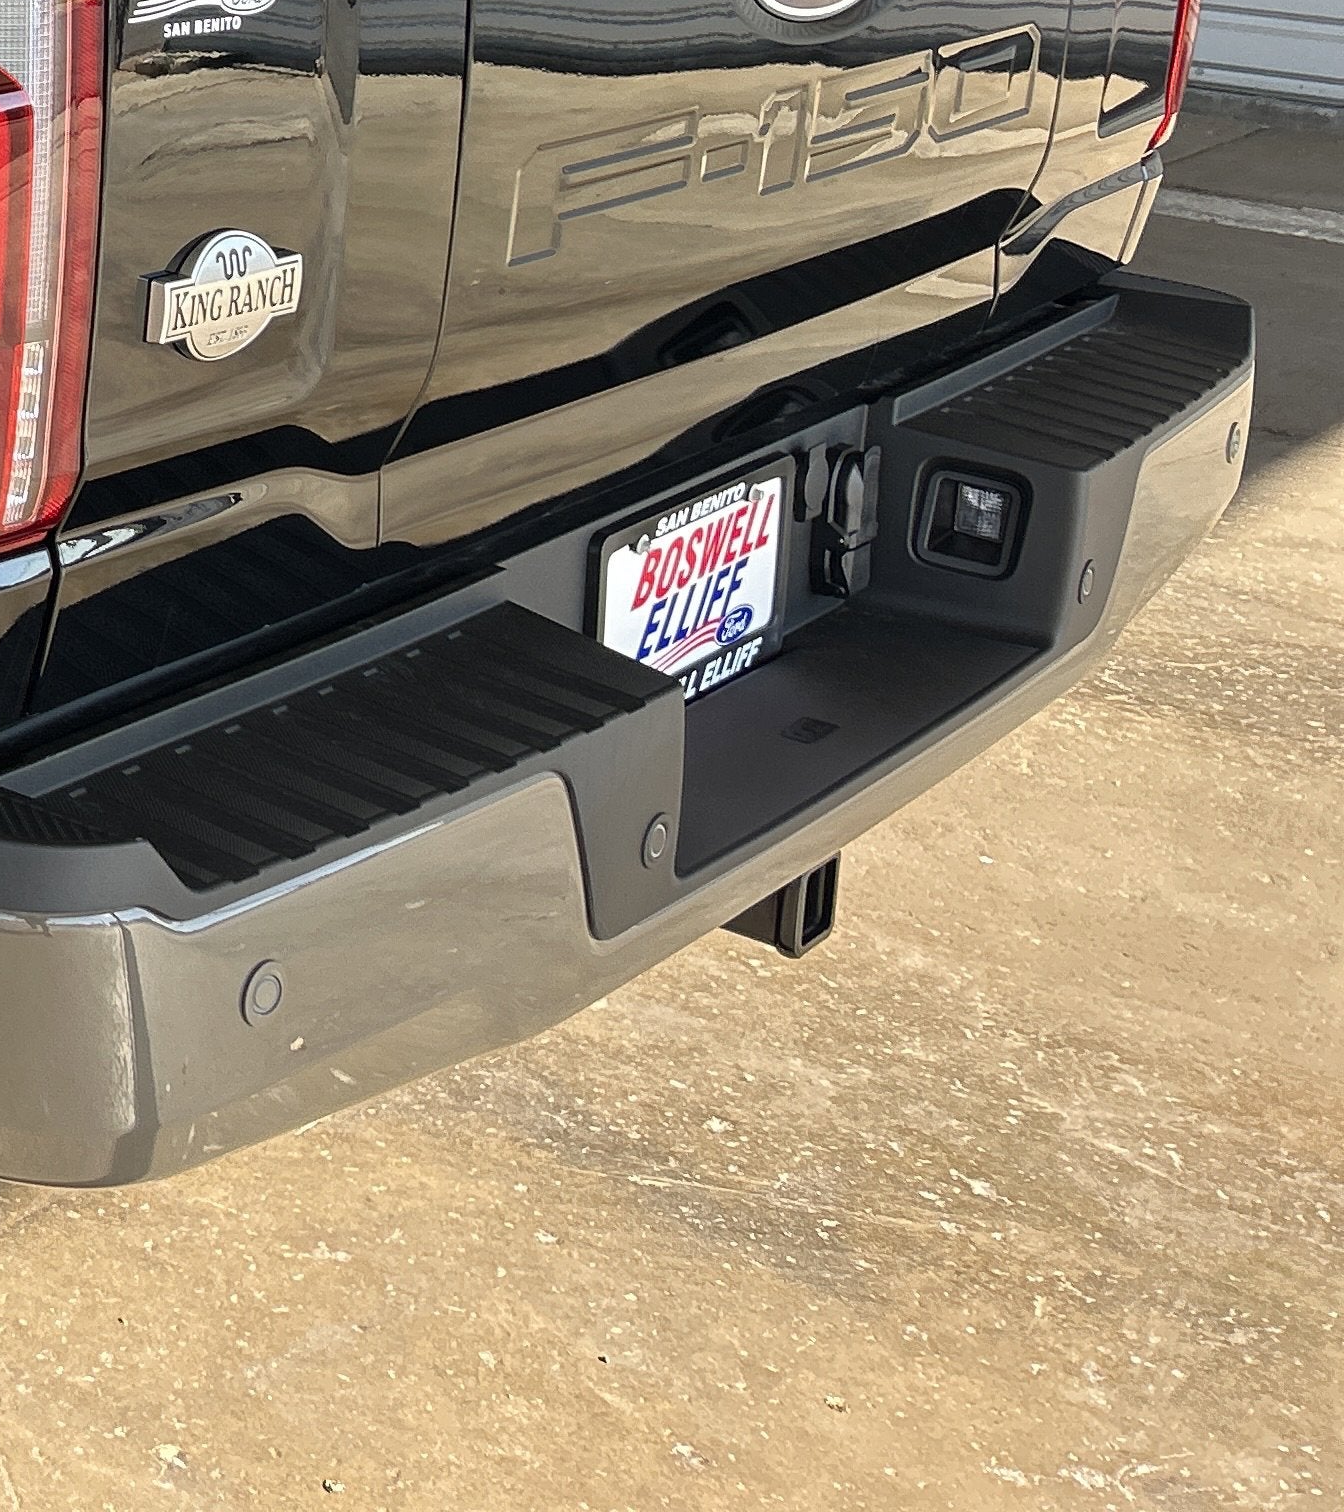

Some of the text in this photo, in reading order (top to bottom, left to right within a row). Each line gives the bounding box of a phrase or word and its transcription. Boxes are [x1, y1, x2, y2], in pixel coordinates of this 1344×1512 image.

[163, 16, 242, 38] SAN BENITO
[507, 21, 1041, 267] F-150
[172, 267, 295, 330] KING RANCH
[655, 481, 746, 537] SAN BENITO
[630, 493, 776, 612] BOSWELL
[635, 556, 749, 662] ELLIFF
[699, 637, 763, 691] ELLIFF
